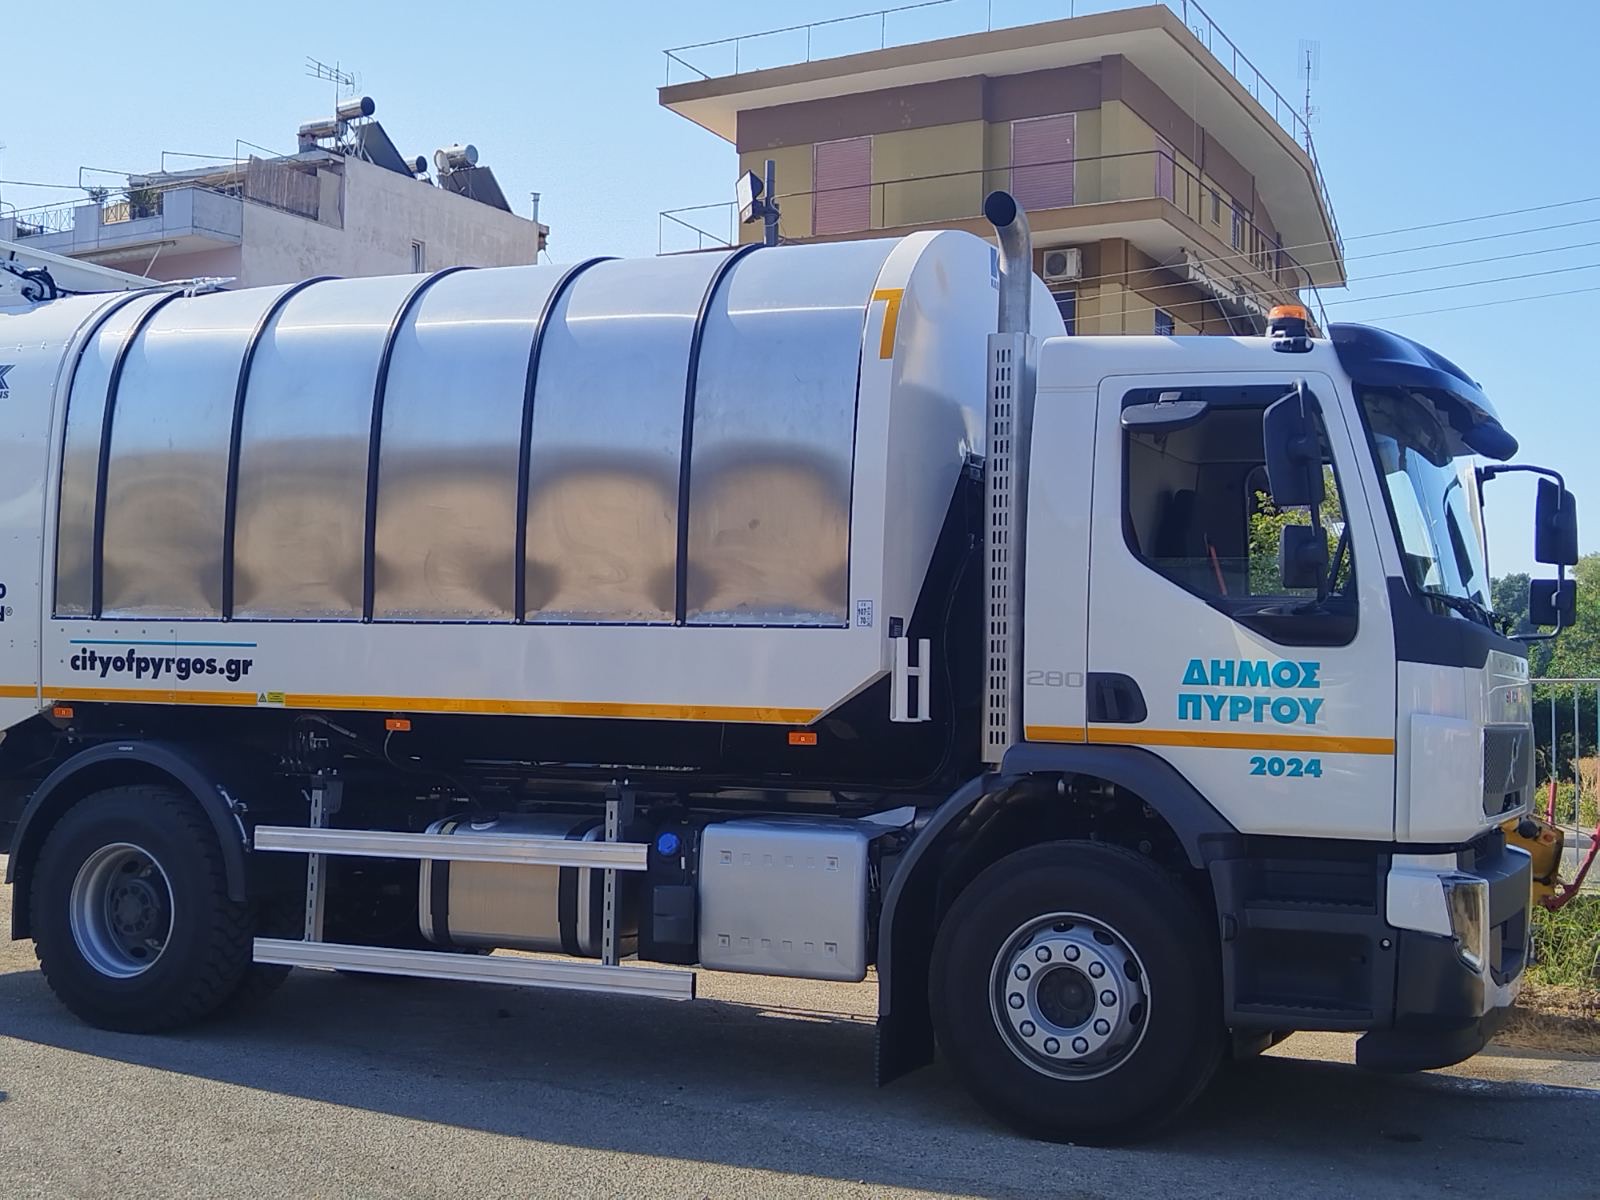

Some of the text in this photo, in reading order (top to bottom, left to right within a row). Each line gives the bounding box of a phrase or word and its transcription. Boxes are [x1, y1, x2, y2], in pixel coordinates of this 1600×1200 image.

[70, 647, 253, 682] cityofpyrgos.gr
[1026, 670, 1084, 688] 280
[1182, 658, 1321, 689] ΔΗΜΟΣ
[1178, 693, 1325, 725] ΠΥΡΓΟΥ
[1249, 756, 1323, 778] 2024
